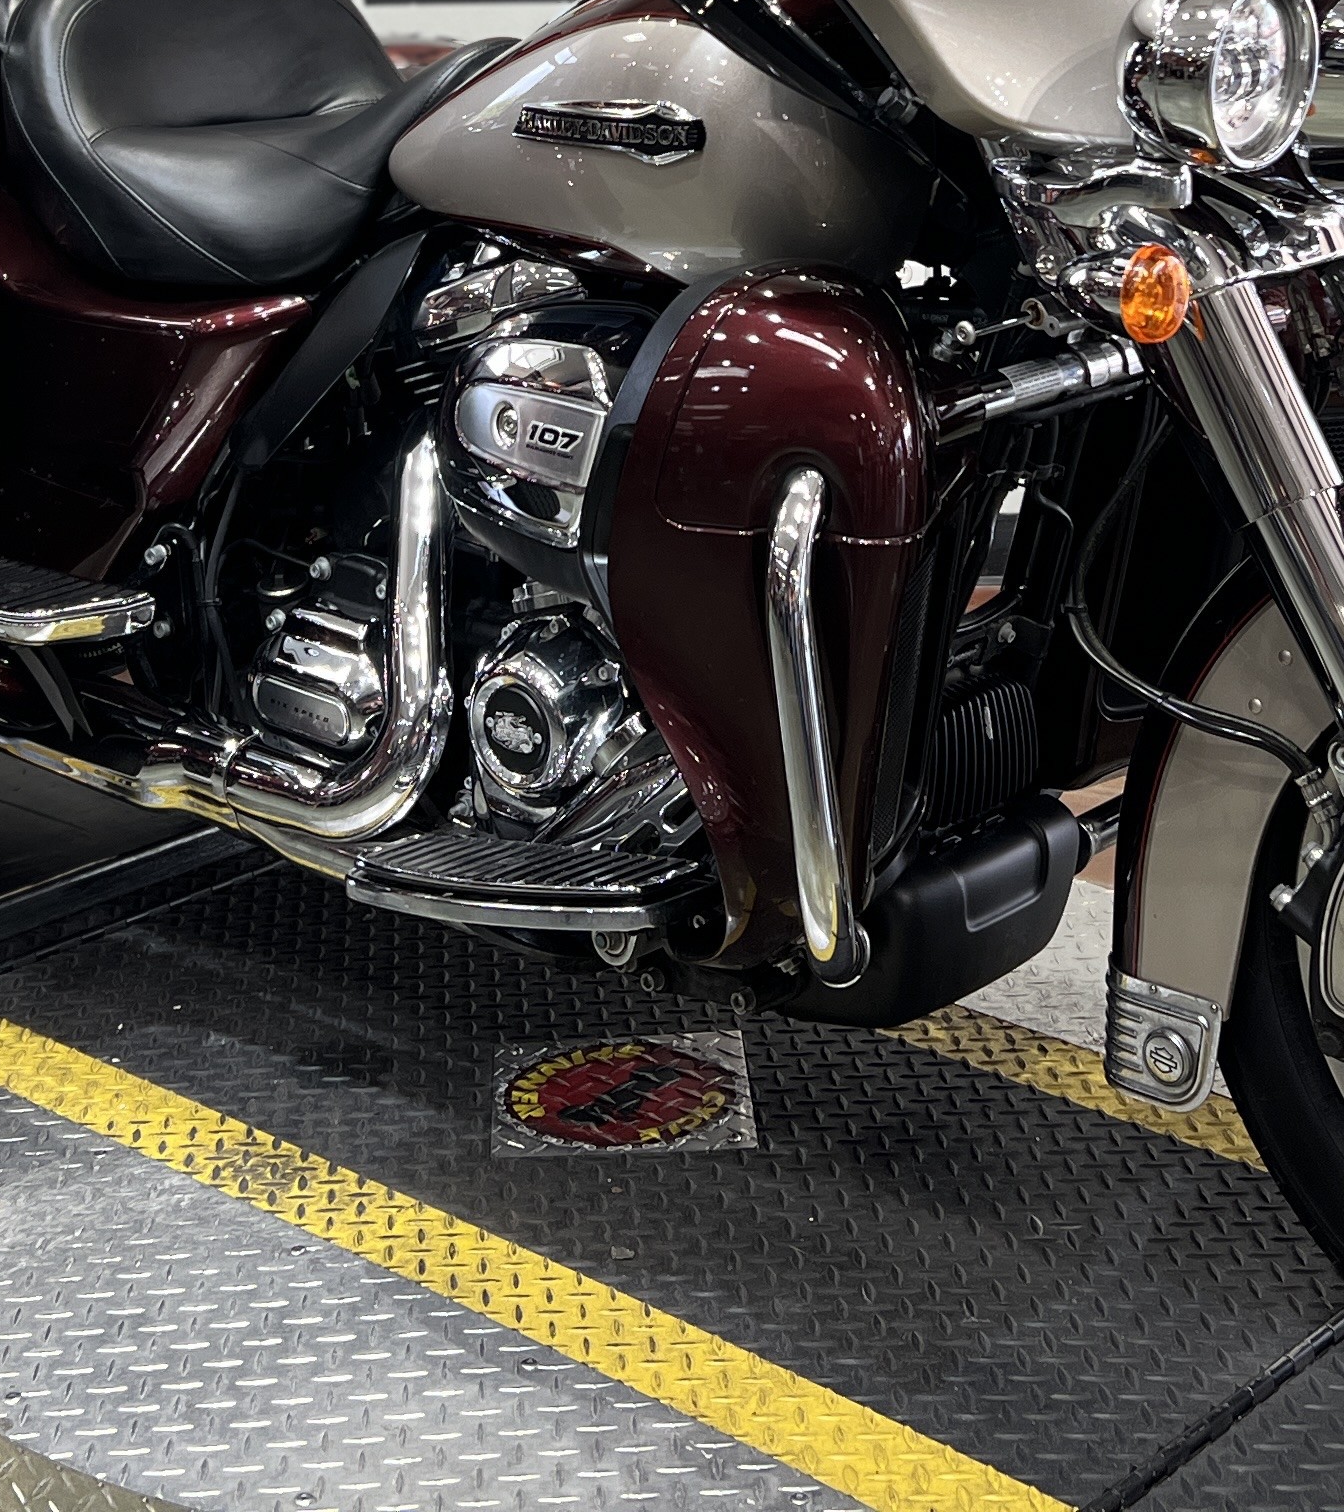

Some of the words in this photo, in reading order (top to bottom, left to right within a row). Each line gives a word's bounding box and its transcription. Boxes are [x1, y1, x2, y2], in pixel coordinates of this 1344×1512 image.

[520, 109, 690, 147] HARLEY-DAVIDSON
[525, 420, 584, 452] 107
[511, 1042, 646, 1121] SPINNER
